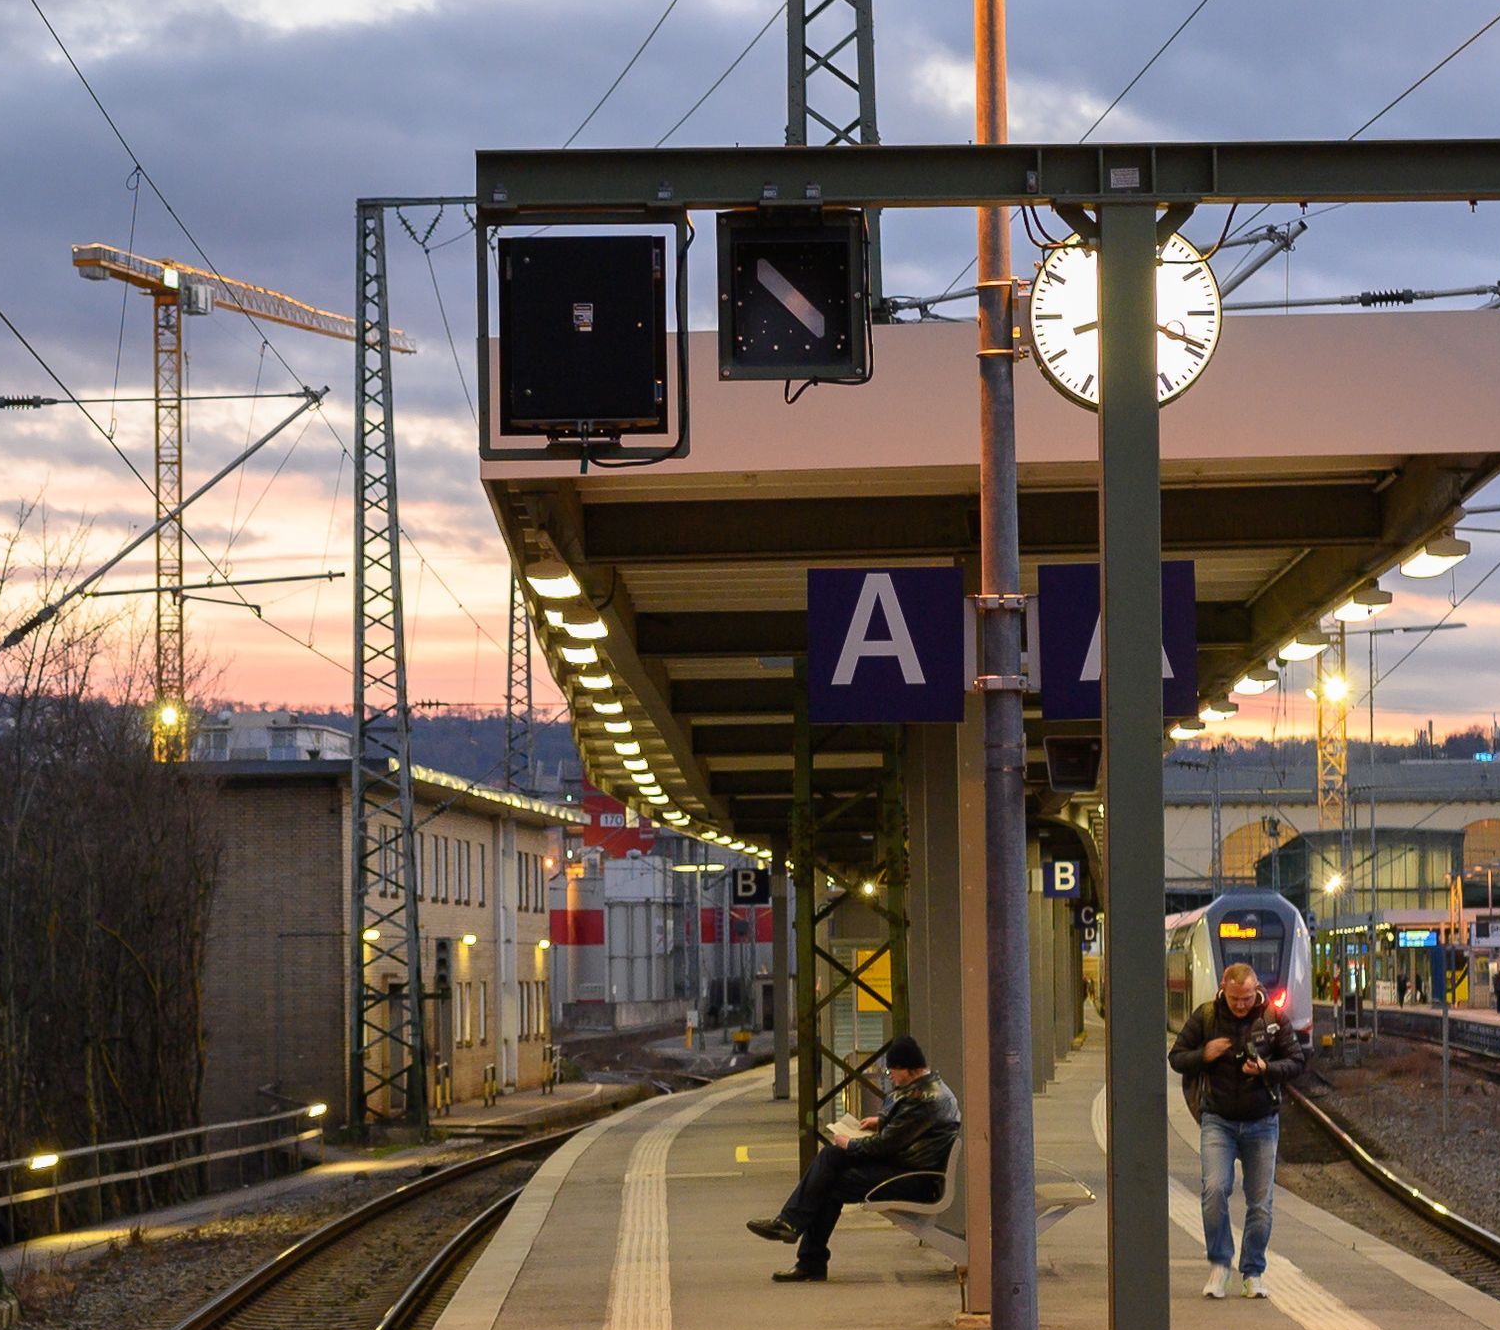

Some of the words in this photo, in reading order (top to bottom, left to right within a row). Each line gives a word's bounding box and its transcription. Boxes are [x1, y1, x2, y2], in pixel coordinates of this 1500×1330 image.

[831, 572, 927, 685] A
[603, 813, 624, 826] 170
[737, 870, 757, 897] B
[1054, 861, 1076, 891] B
[1081, 906, 1094, 924] C
[1084, 928, 1095, 941] D
